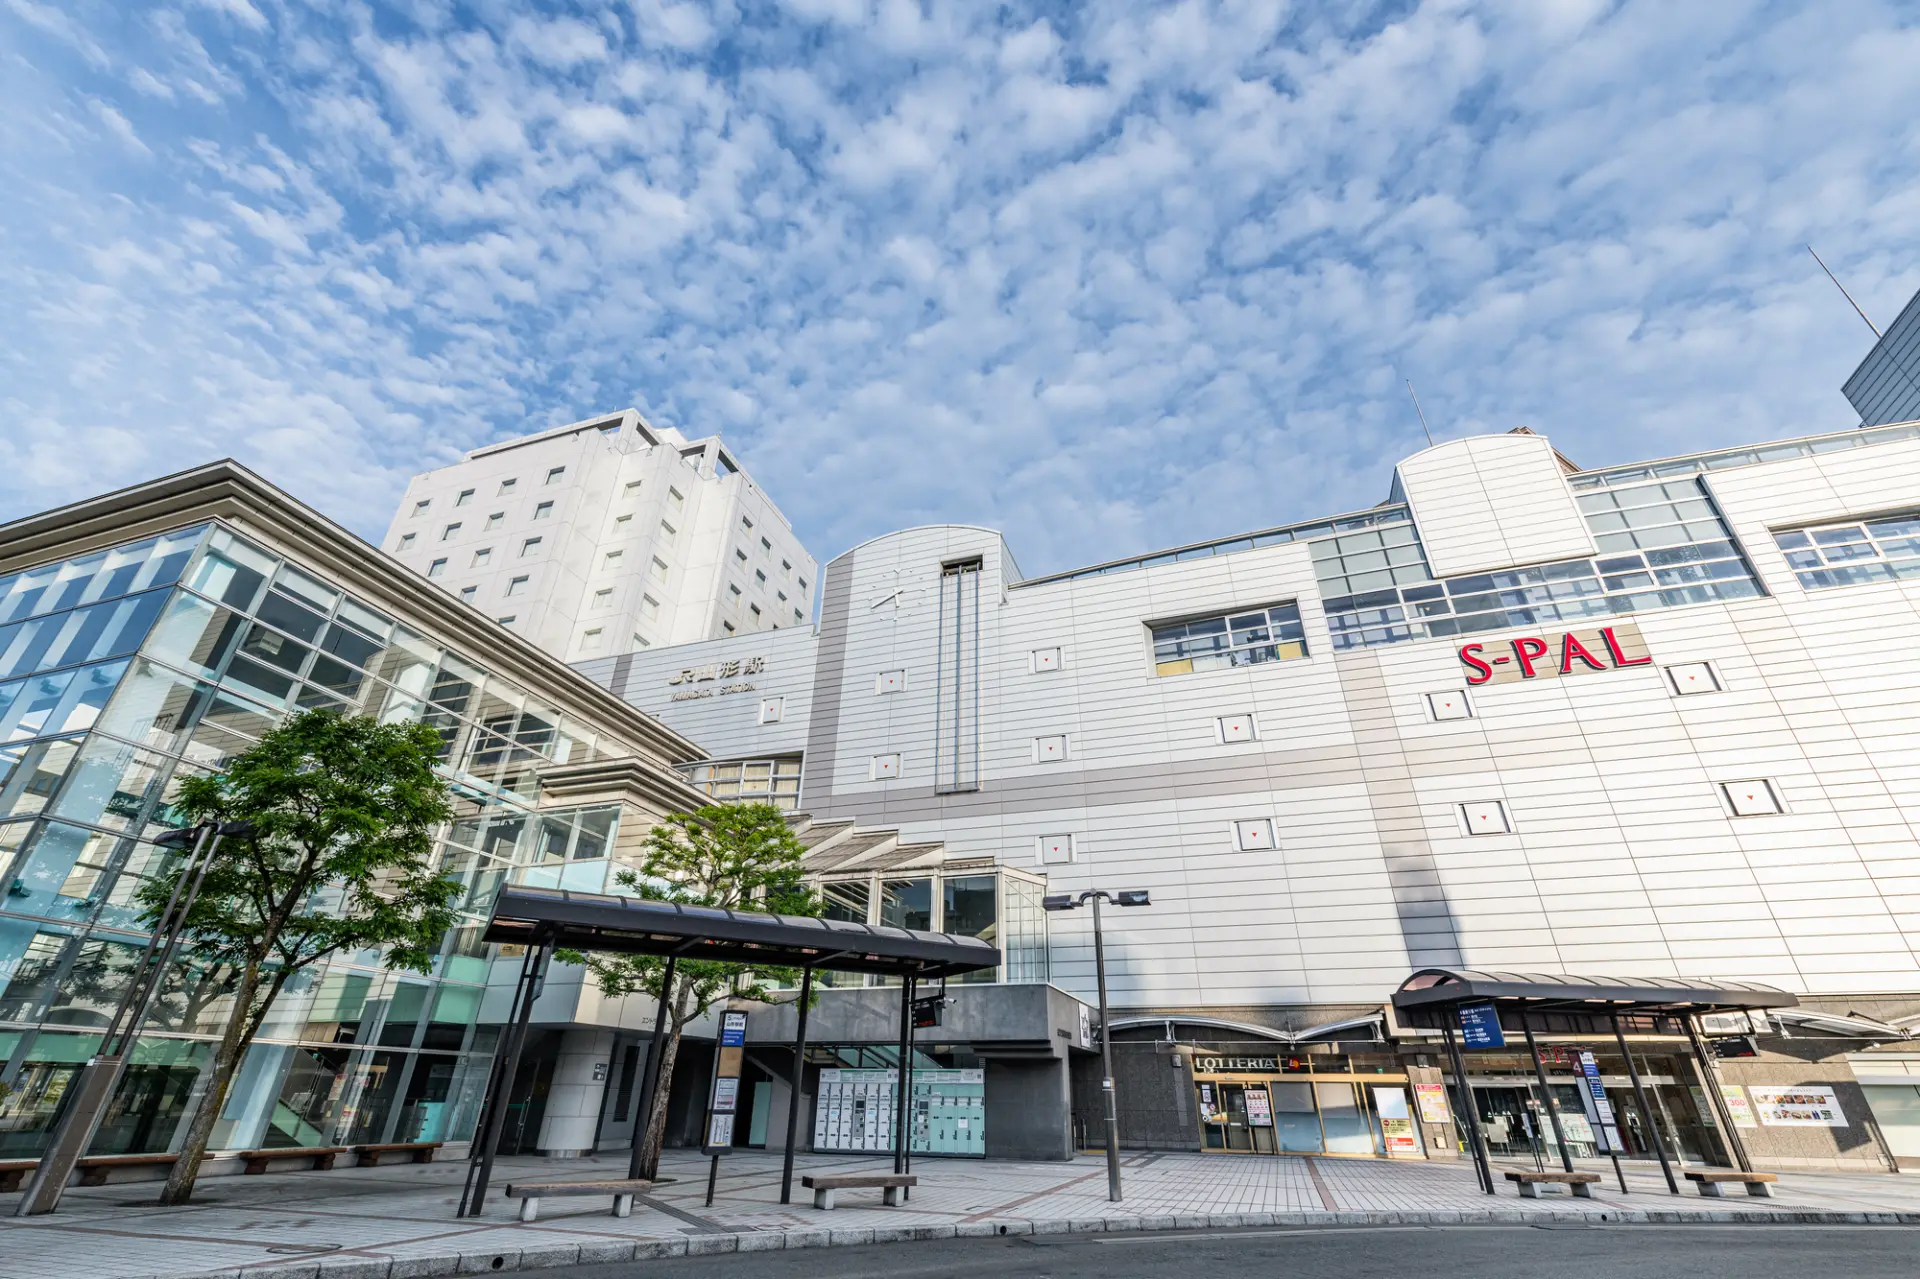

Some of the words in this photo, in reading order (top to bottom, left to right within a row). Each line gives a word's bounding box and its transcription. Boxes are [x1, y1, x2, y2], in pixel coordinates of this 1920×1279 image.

[1459, 627, 1652, 685] S-PAL
[671, 689, 713, 702] YAMAGATA
[720, 682, 756, 696] STATION
[1195, 1056, 1277, 1069] LOTTERIA
[1573, 1062, 1582, 1073] 4
